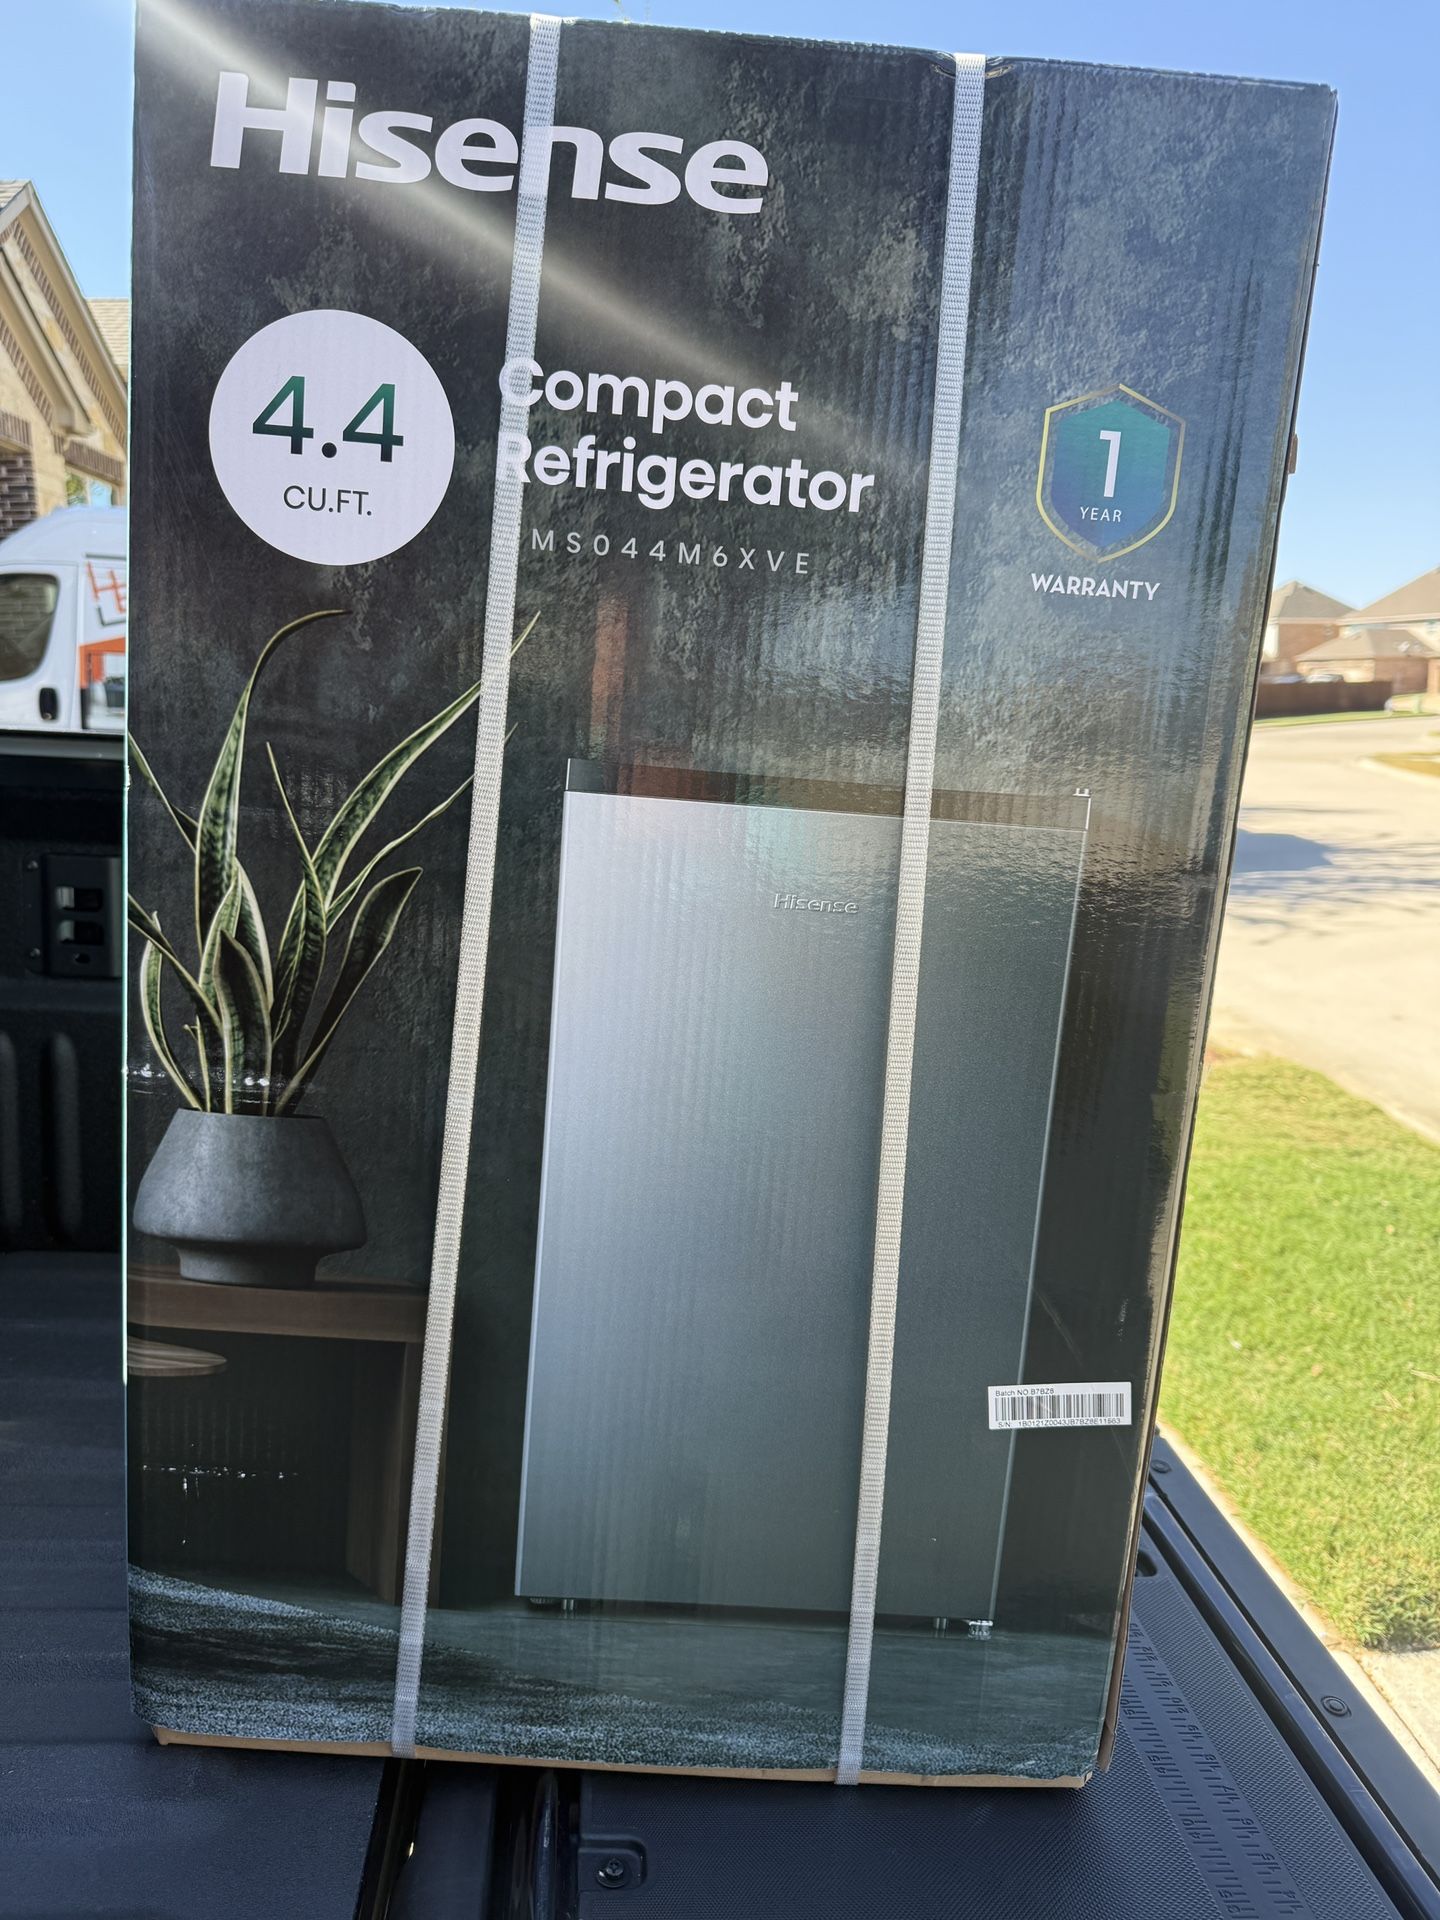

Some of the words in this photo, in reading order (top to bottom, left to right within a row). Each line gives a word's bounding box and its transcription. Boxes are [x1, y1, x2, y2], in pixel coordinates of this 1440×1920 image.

[210, 71, 768, 214] Hisense
[252, 374, 404, 463] 4.4
[499, 356, 799, 434] Compact
[497, 431, 875, 512] Refrigerator
[1100, 430, 1121, 498] 1
[283, 484, 372, 516] CU.FT.
[1080, 506, 1122, 523] YEAR
[531, 528, 809, 575] MS044M6XVE
[1031, 573, 1161, 601] WARRANTY
[774, 893, 859, 914] Hisense
[995, 1389, 1015, 1397] Batch
